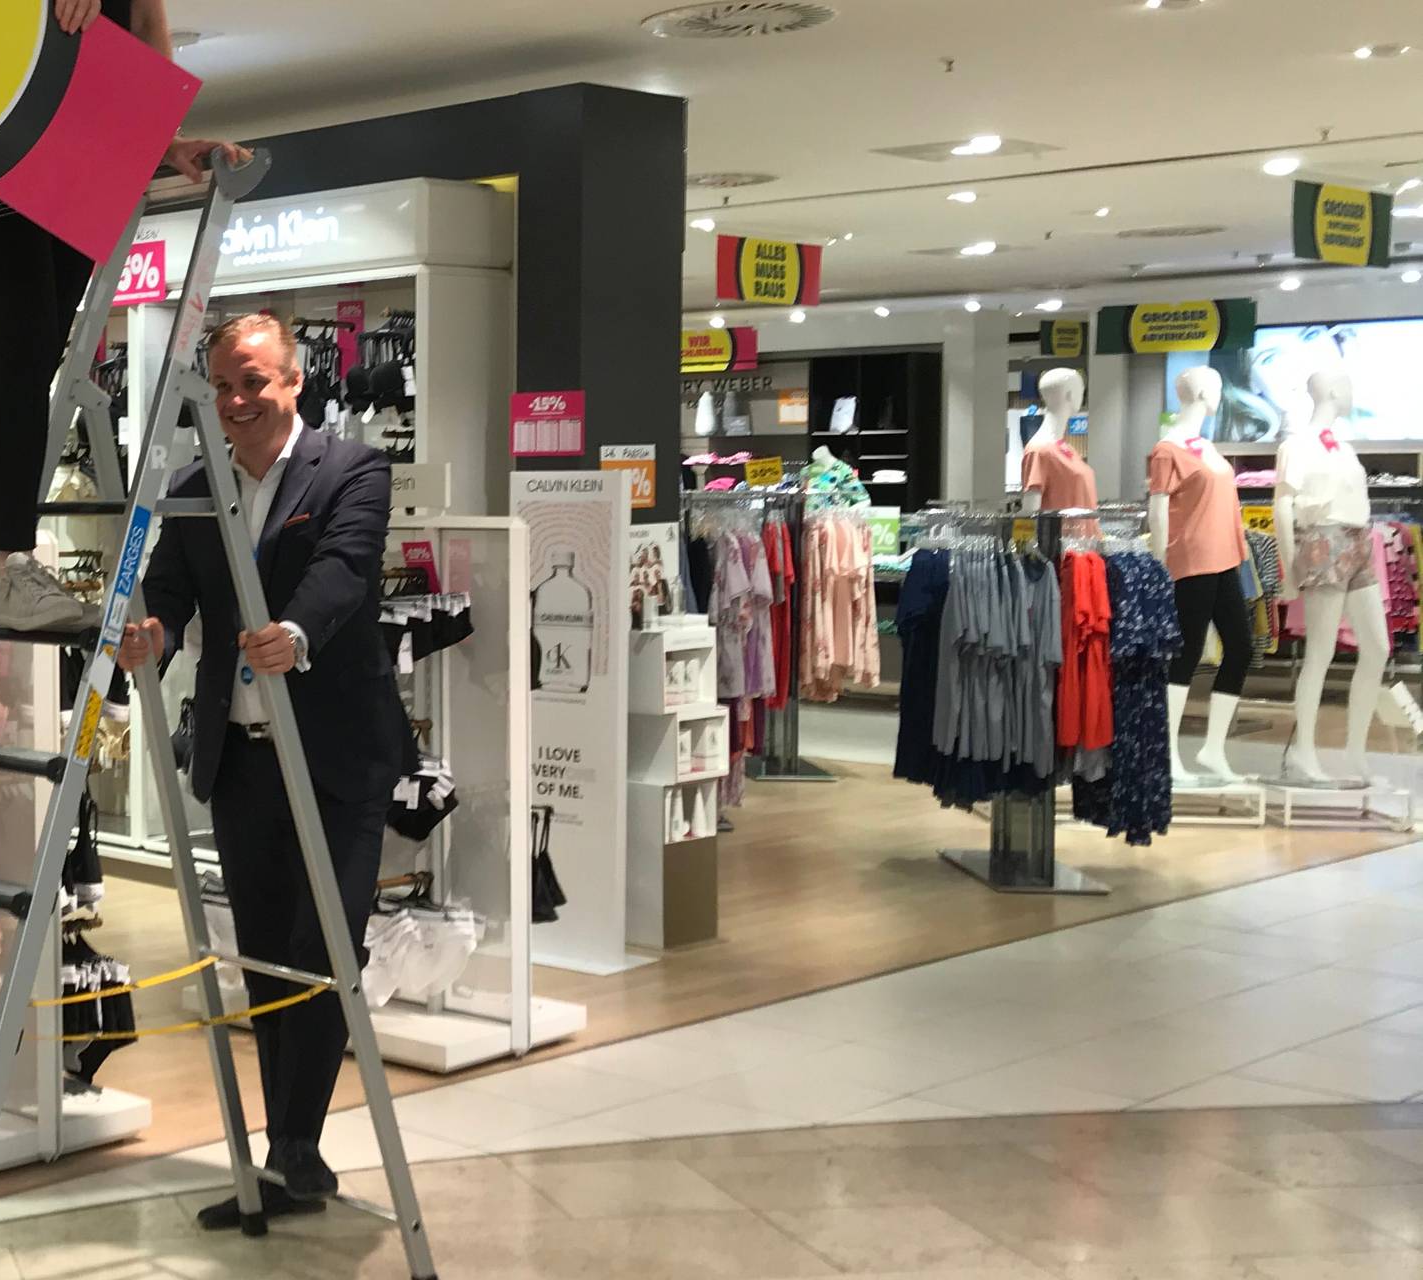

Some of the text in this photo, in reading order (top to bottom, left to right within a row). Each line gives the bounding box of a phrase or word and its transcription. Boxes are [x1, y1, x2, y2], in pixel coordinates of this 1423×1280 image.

[219, 207, 339, 256] alvin Klein
[755, 243, 787, 261] ALLES
[754, 262, 787, 280] MUSS
[754, 281, 787, 298] RAUS
[713, 375, 773, 393] WEBER
[528, 395, 567, 412] -15%
[150, 446, 168, 470] R
[526, 479, 604, 494] CALVIN KLEIN
[1249, 517, 1274, 530] 50
[117, 525, 145, 594] ZARGES
[538, 746, 582, 763] I LOVE
[531, 763, 566, 779] VERY
[537, 781, 584, 800] OF ME.
